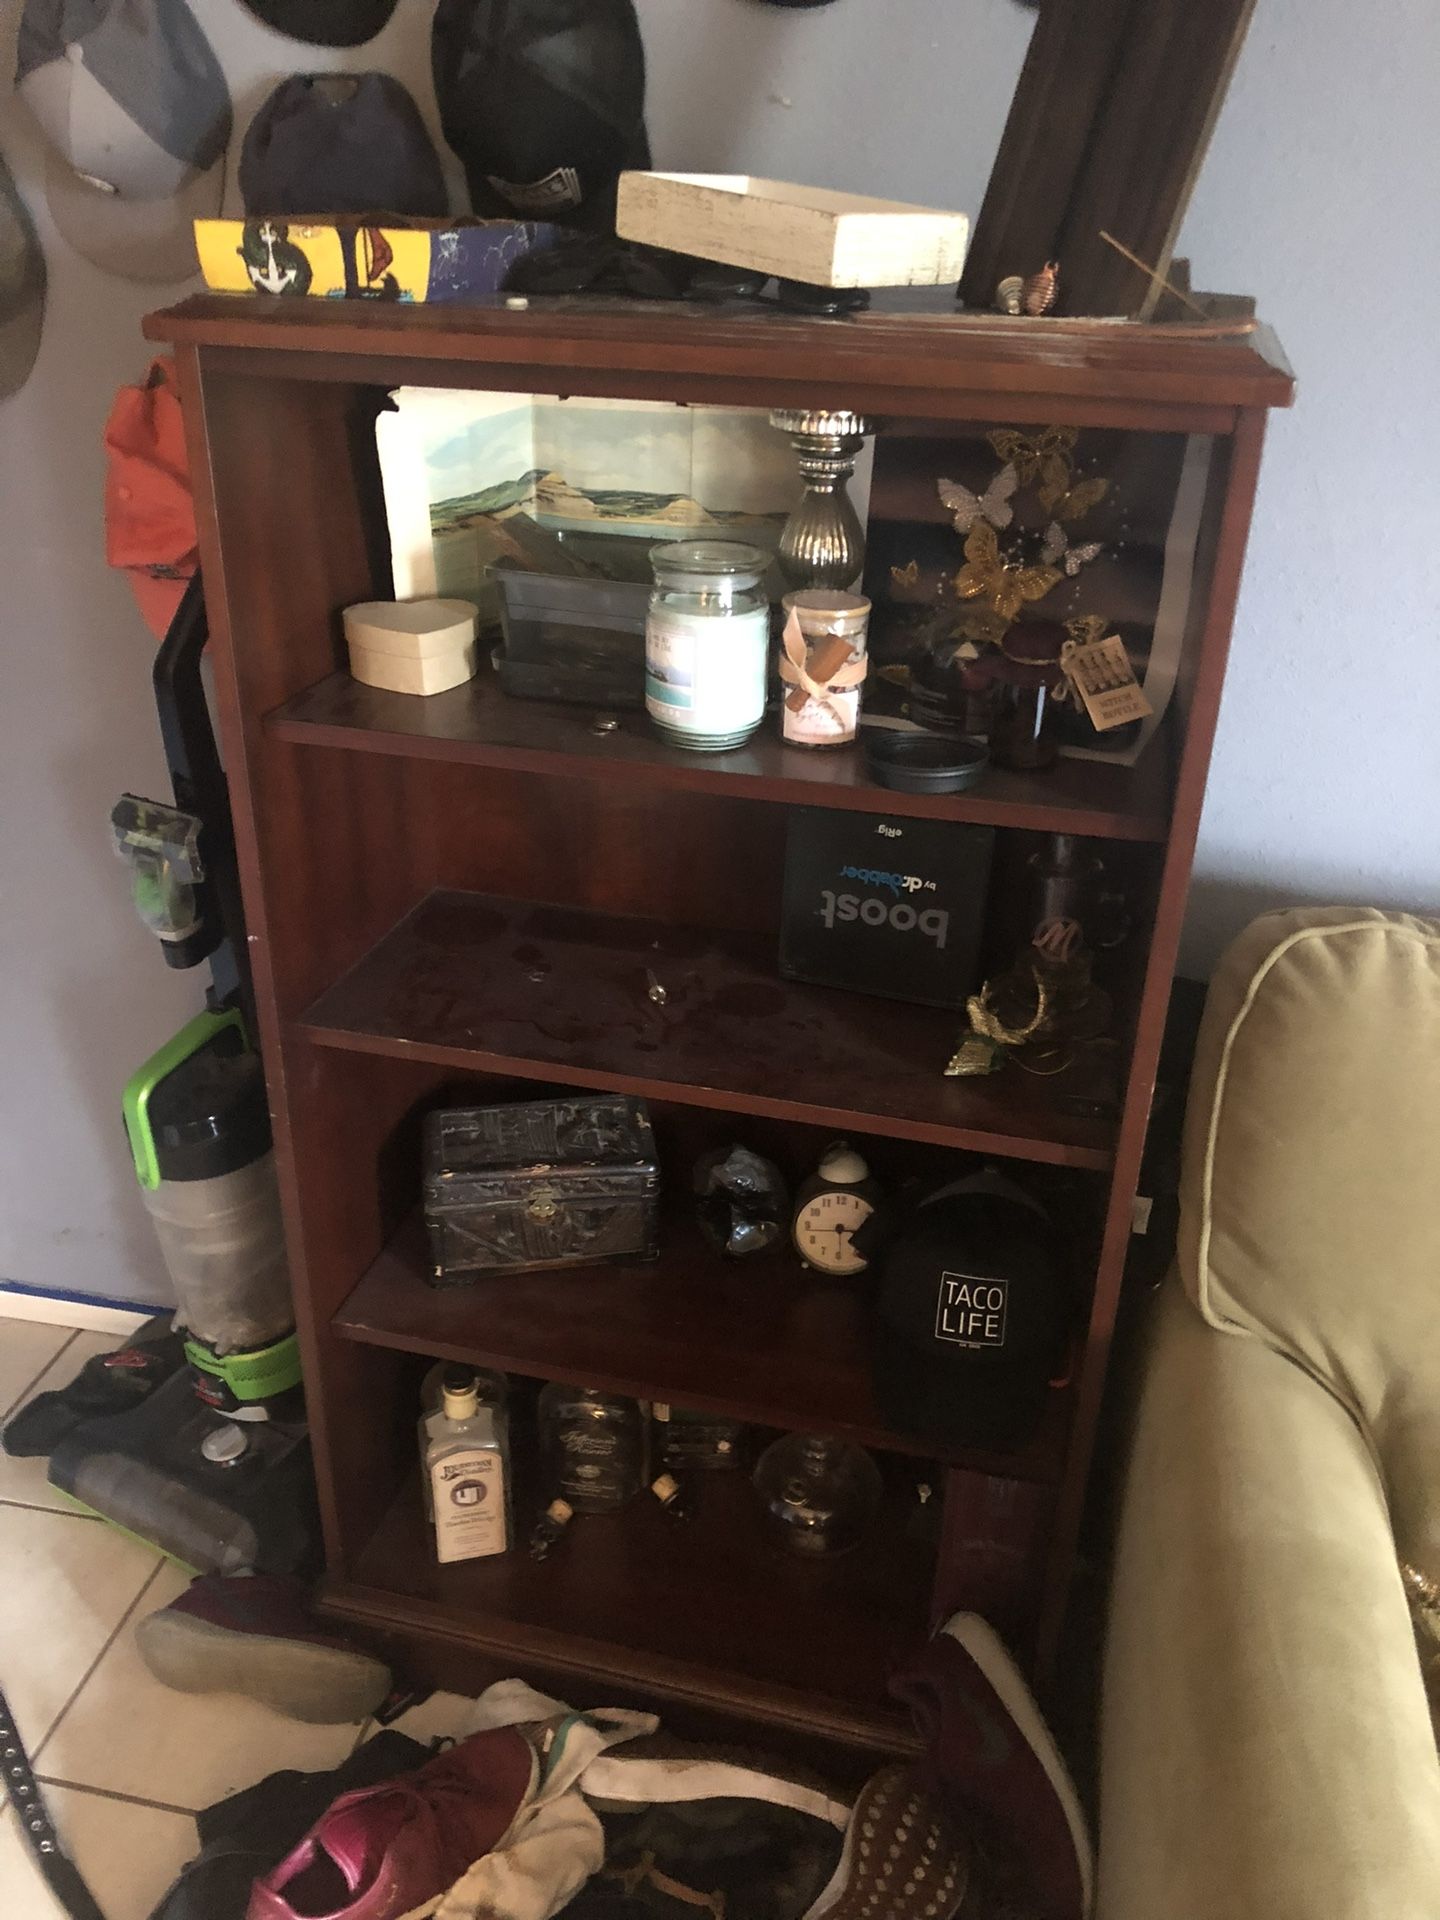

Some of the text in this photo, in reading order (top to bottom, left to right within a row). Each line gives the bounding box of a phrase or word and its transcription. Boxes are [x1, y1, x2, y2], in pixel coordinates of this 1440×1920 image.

[924, 880, 936, 891] by
[820, 890, 949, 949] boost
[822, 1198, 831, 1208] 11
[836, 1195, 847, 1206] 12
[945, 1280, 1003, 1311] TACO
[942, 1308, 999, 1338] LIFE
